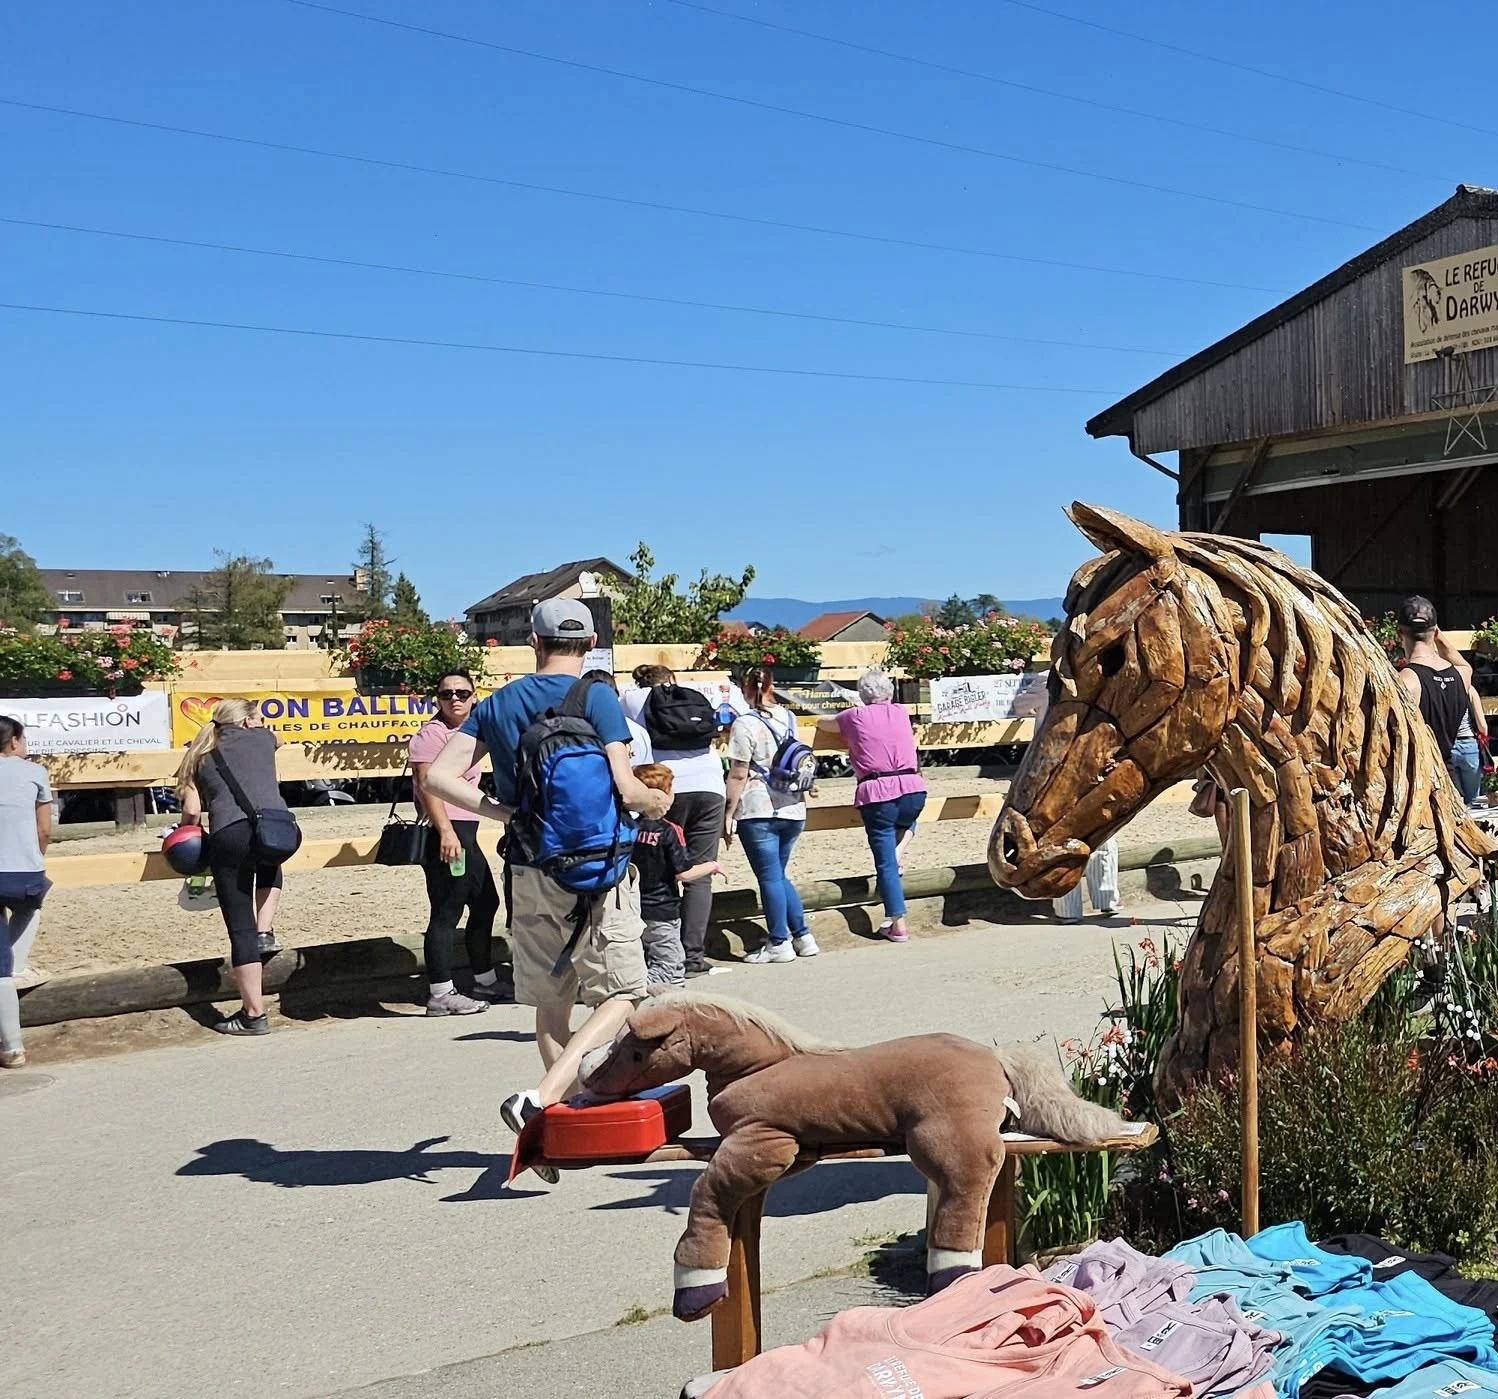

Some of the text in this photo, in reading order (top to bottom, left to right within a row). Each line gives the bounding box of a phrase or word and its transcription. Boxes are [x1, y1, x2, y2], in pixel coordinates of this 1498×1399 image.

[1445, 266, 1460, 287] LE
[1473, 280, 1485, 293] DE
[937, 697, 963, 714] GARAGE
[309, 722, 331, 731] DE
[55, 738, 100, 747] CAVALIER
[101, 738, 112, 746] ET
[114, 737, 124, 746] LE
[126, 736, 161, 745] CHEVAL
